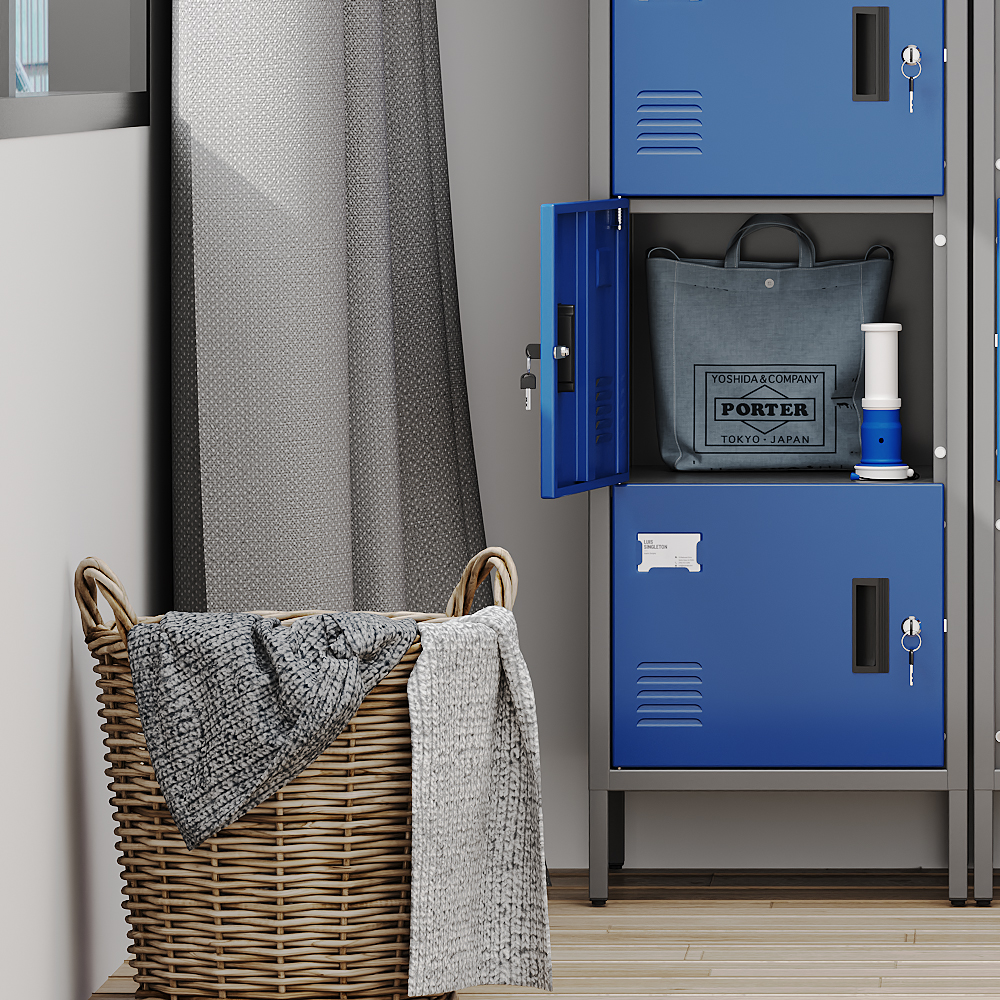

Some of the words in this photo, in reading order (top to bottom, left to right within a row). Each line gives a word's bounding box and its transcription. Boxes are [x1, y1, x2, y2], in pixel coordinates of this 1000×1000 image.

[721, 403, 809, 417] PORTER
[721, 435, 760, 444] TOKYO
[770, 435, 810, 444] JAPAN
